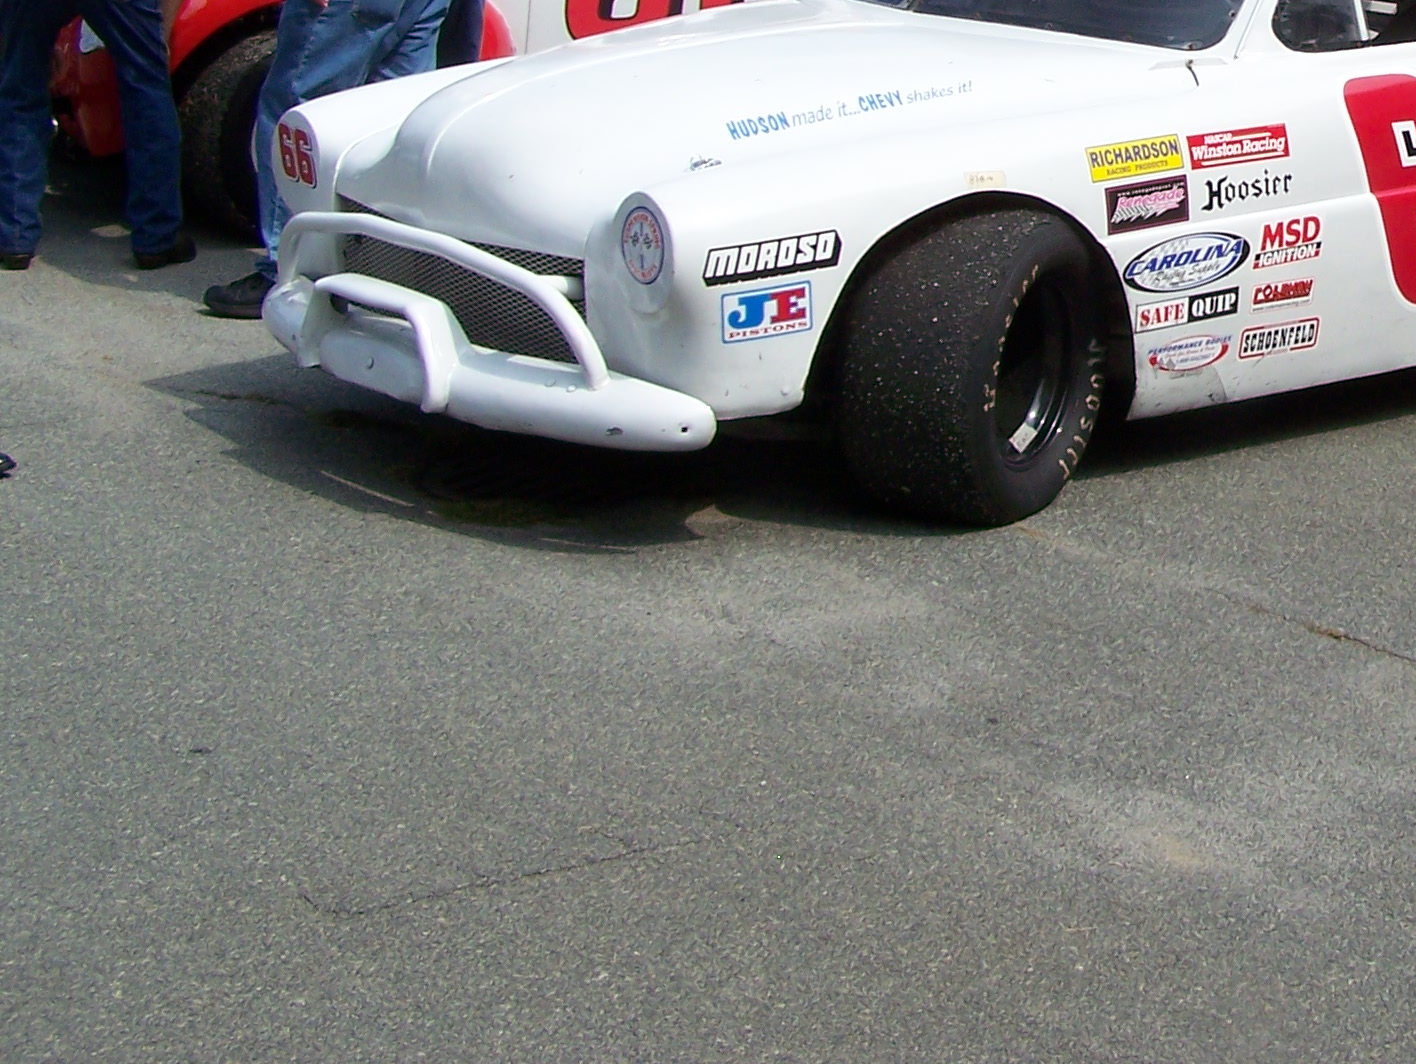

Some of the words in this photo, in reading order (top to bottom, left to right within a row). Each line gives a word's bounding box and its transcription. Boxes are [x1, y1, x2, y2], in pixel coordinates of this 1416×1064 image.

[726, 111, 790, 140] HUDSON
[792, 105, 833, 127] made
[907, 85, 953, 104] shakes
[278, 122, 318, 189] 66
[1089, 139, 1179, 168] RICHARDSON
[1192, 142, 1241, 160] Winston
[1242, 136, 1285, 153] Racing
[1204, 133, 1232, 144] NASCAR
[1201, 169, 1293, 211] Hoosier
[1261, 216, 1320, 251] MSD
[703, 229, 841, 286] MOROSO
[1126, 238, 1244, 278] CAROLINA
[1259, 243, 1317, 267] IGNITION
[728, 287, 806, 328] JE
[1140, 302, 1184, 327] SAFE
[1191, 293, 1237, 317] QUIP
[728, 322, 808, 338] PISTONS
[1148, 340, 1203, 354] PERFORMANCE
[1243, 324, 1315, 353] SCHOENFELD
